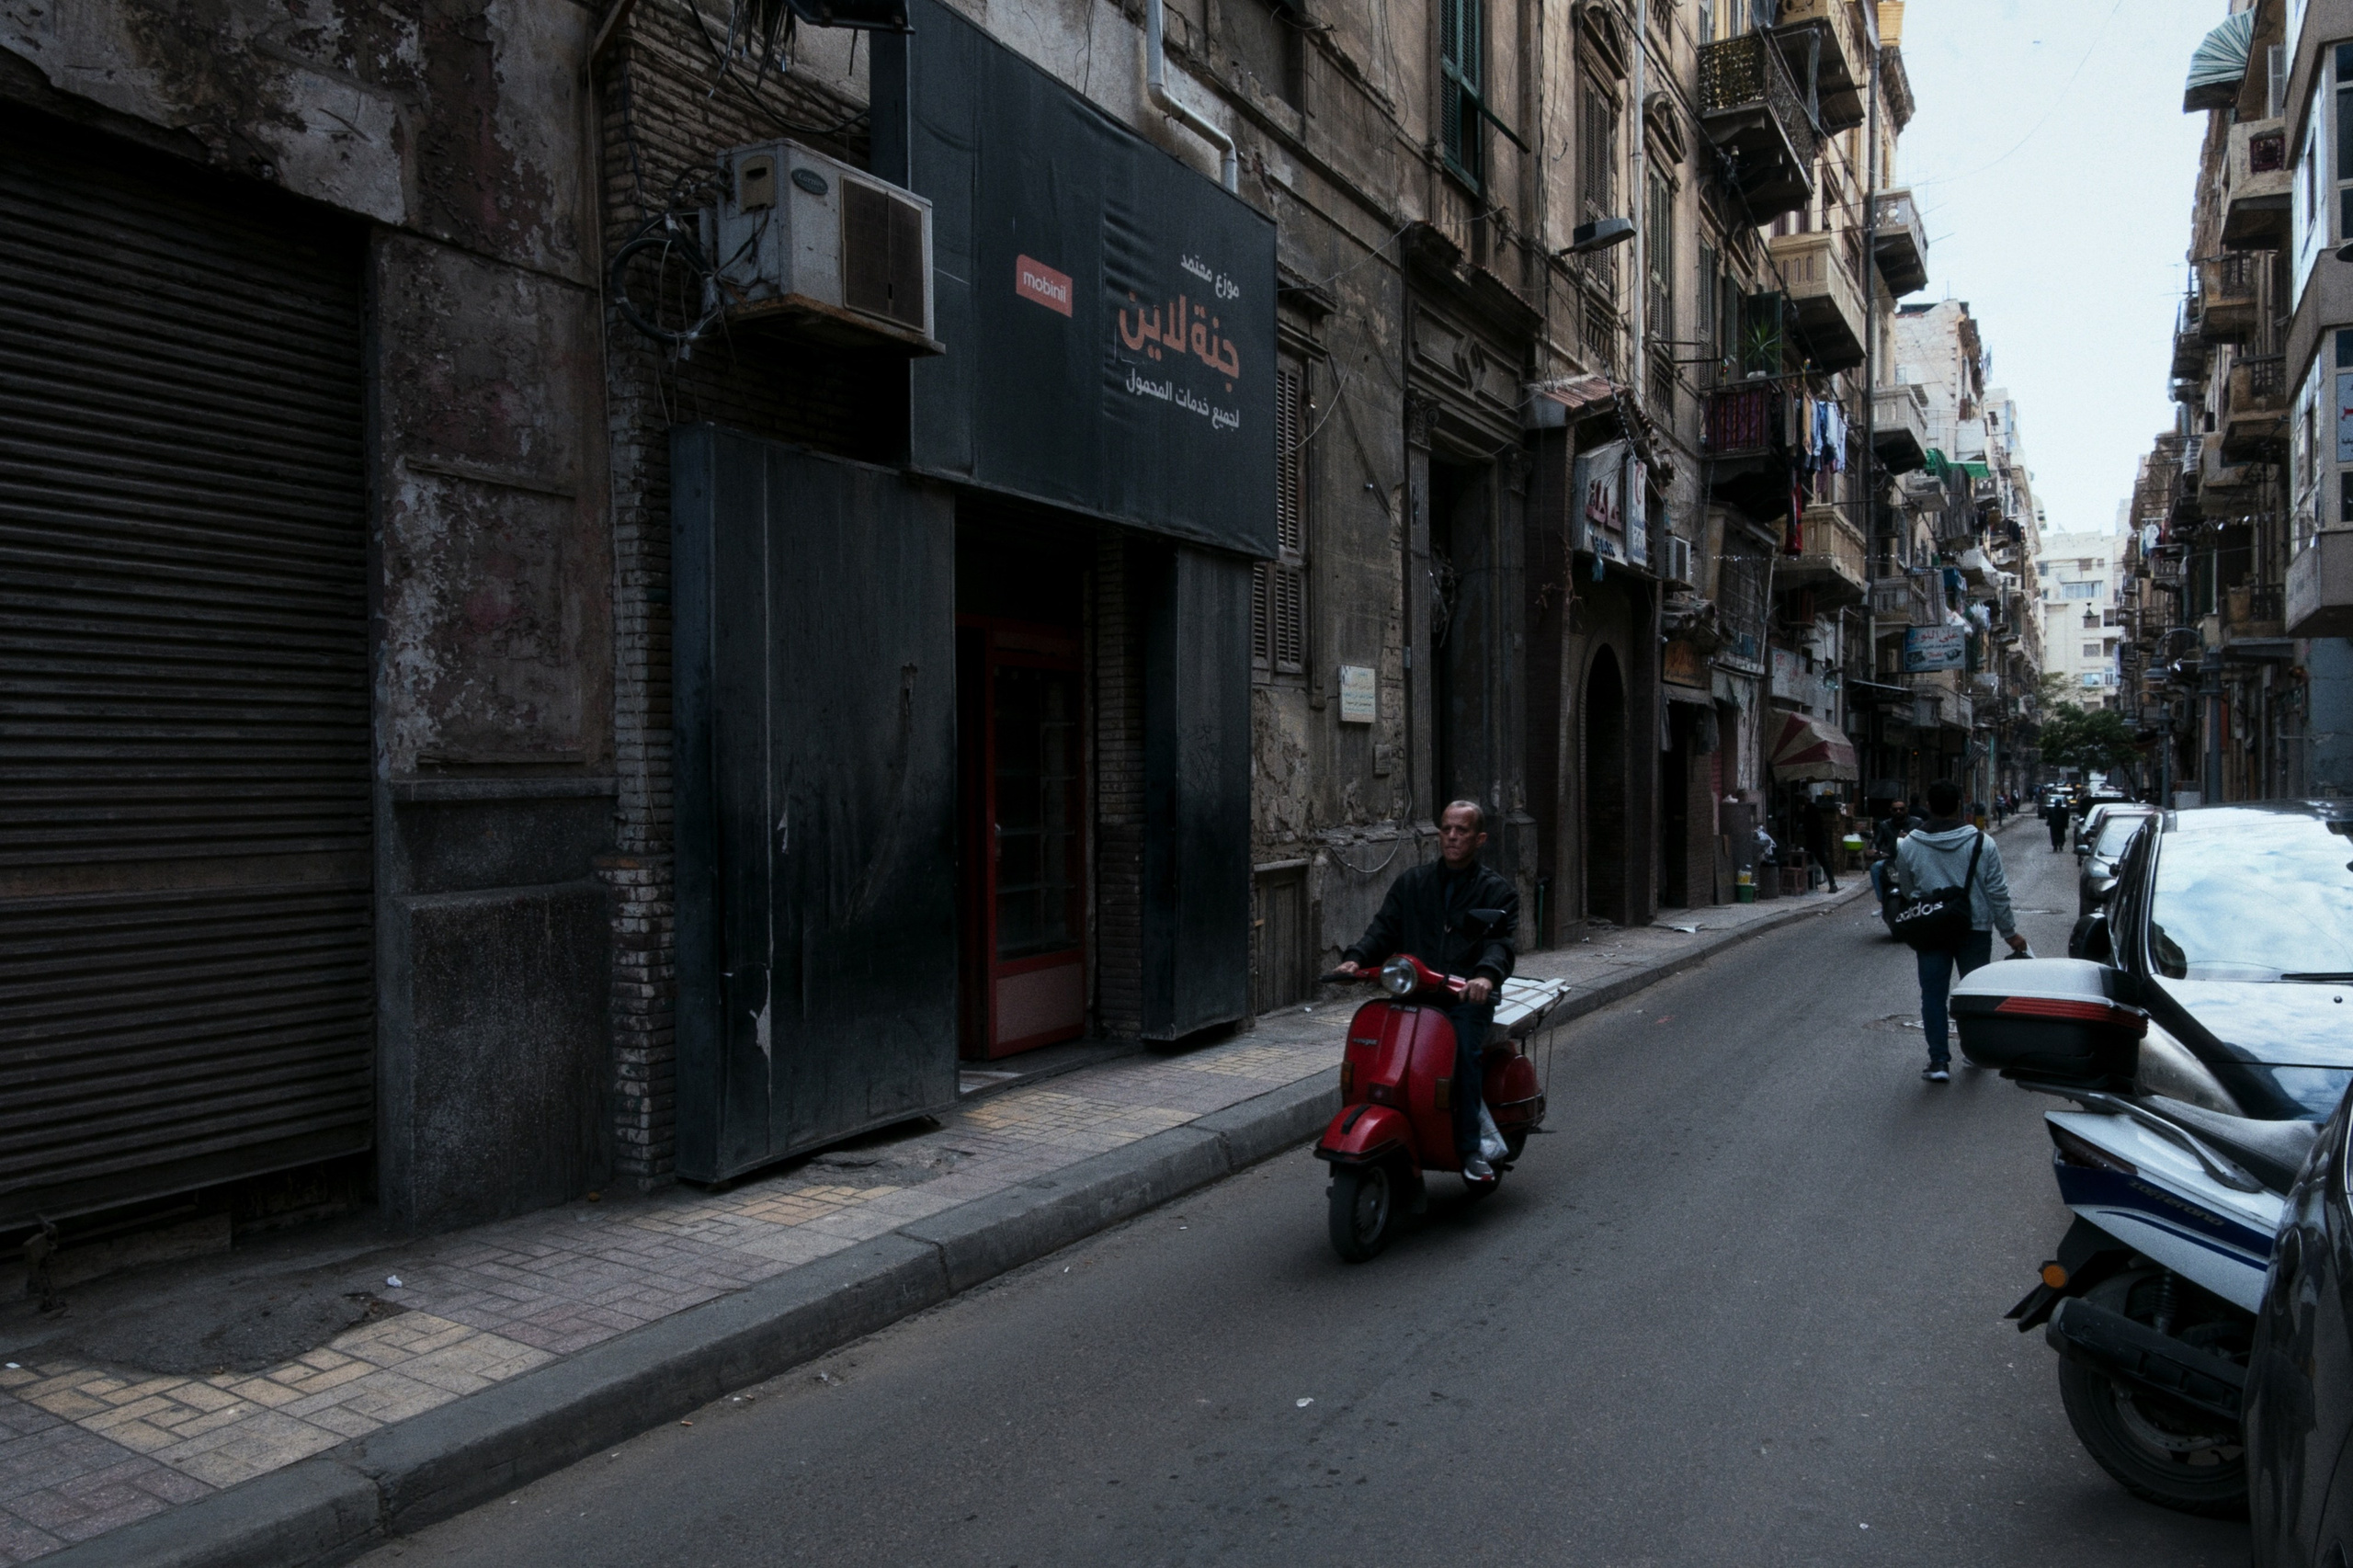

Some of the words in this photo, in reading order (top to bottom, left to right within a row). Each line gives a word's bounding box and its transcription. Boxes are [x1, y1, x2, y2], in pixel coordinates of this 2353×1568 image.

[1181, 254, 1213, 282] معتمد
[1023, 271, 1066, 303] mobinil
[1215, 272, 1240, 300] موزع
[1119, 290, 1187, 361] لاين
[1191, 303, 1240, 393] جنة
[1126, 368, 1173, 401] المحمول
[1176, 388, 1210, 416] خدمات
[1212, 406, 1240, 431] لجميع
